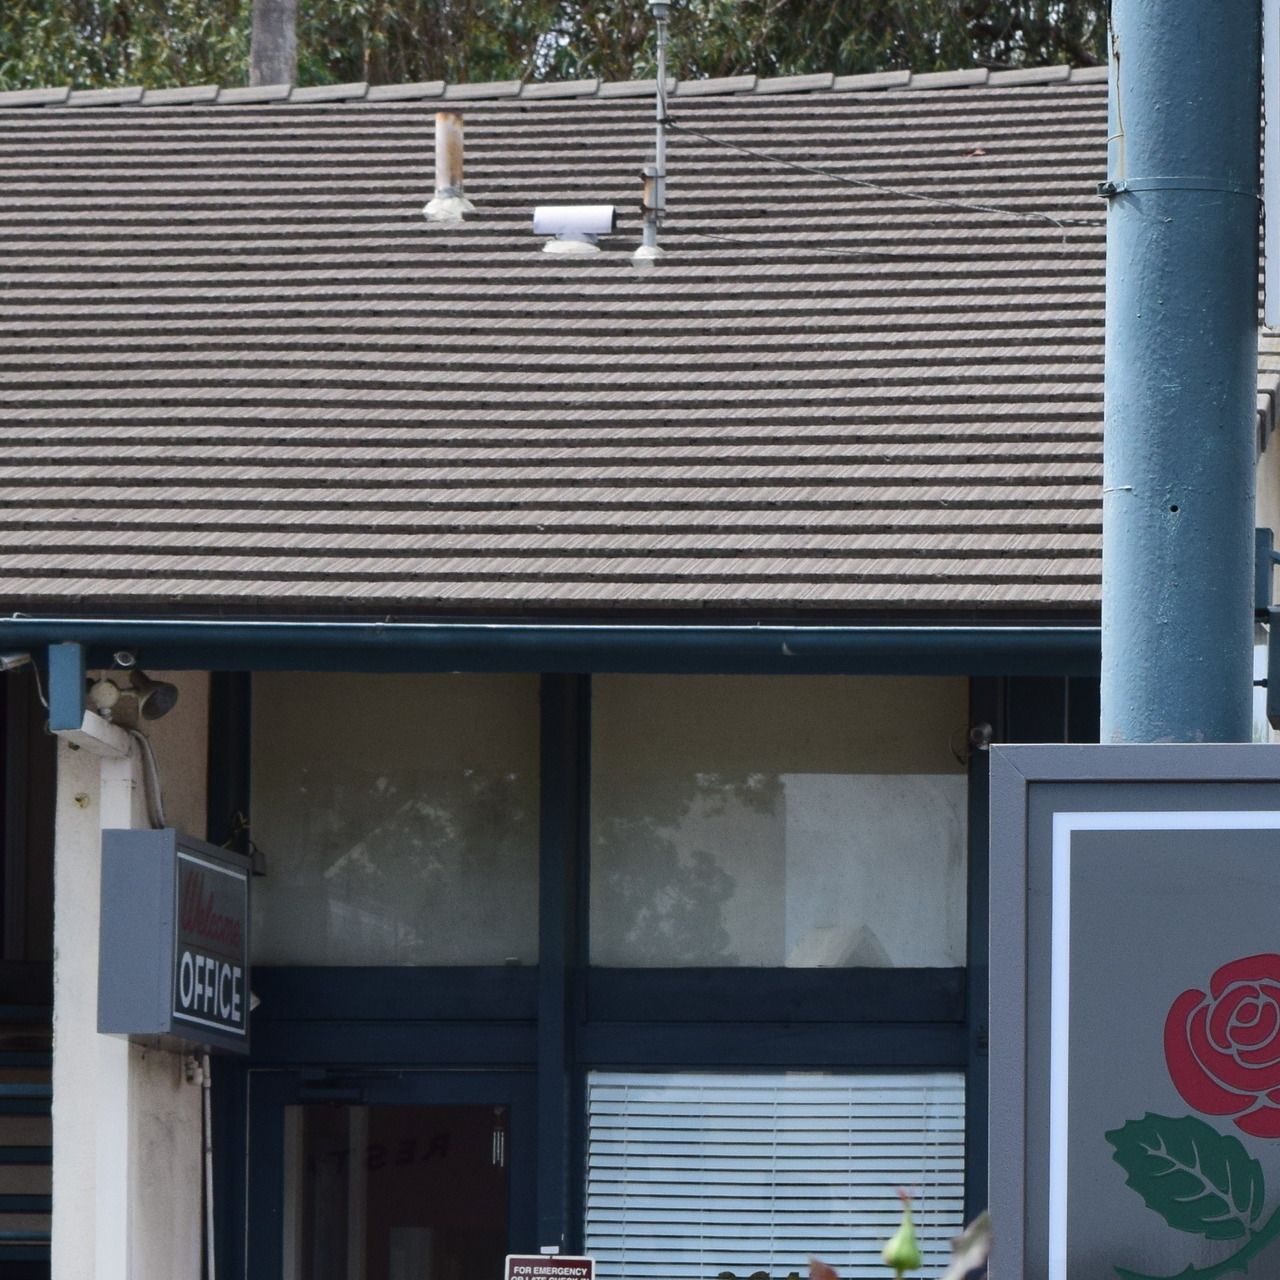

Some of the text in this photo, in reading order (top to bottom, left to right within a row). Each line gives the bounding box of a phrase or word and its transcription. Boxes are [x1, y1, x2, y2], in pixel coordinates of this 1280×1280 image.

[179, 951, 242, 1022] OFFICE
[513, 1266, 588, 1276] FOR EMERGENCY
